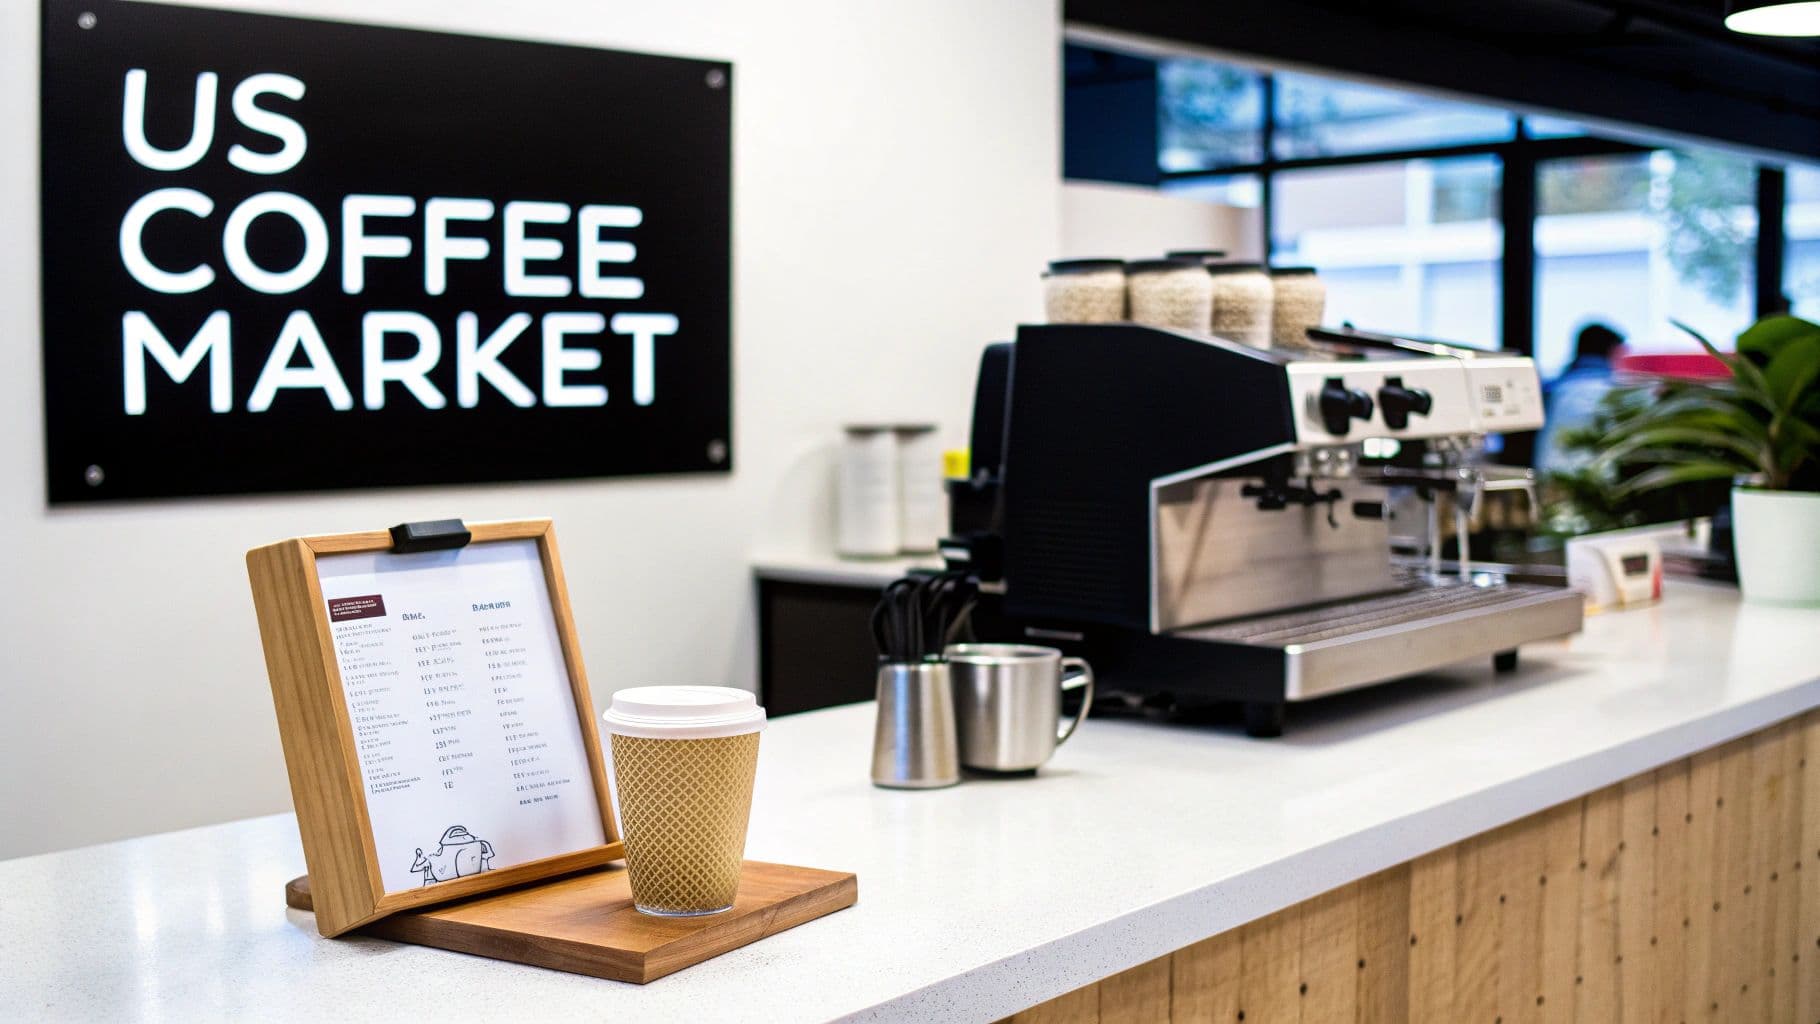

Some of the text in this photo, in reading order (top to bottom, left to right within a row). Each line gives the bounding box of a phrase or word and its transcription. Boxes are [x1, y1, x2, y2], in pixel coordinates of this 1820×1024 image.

[123, 69, 306, 174] US
[120, 188, 643, 298] COFFEE
[123, 311, 678, 414] MARKET
